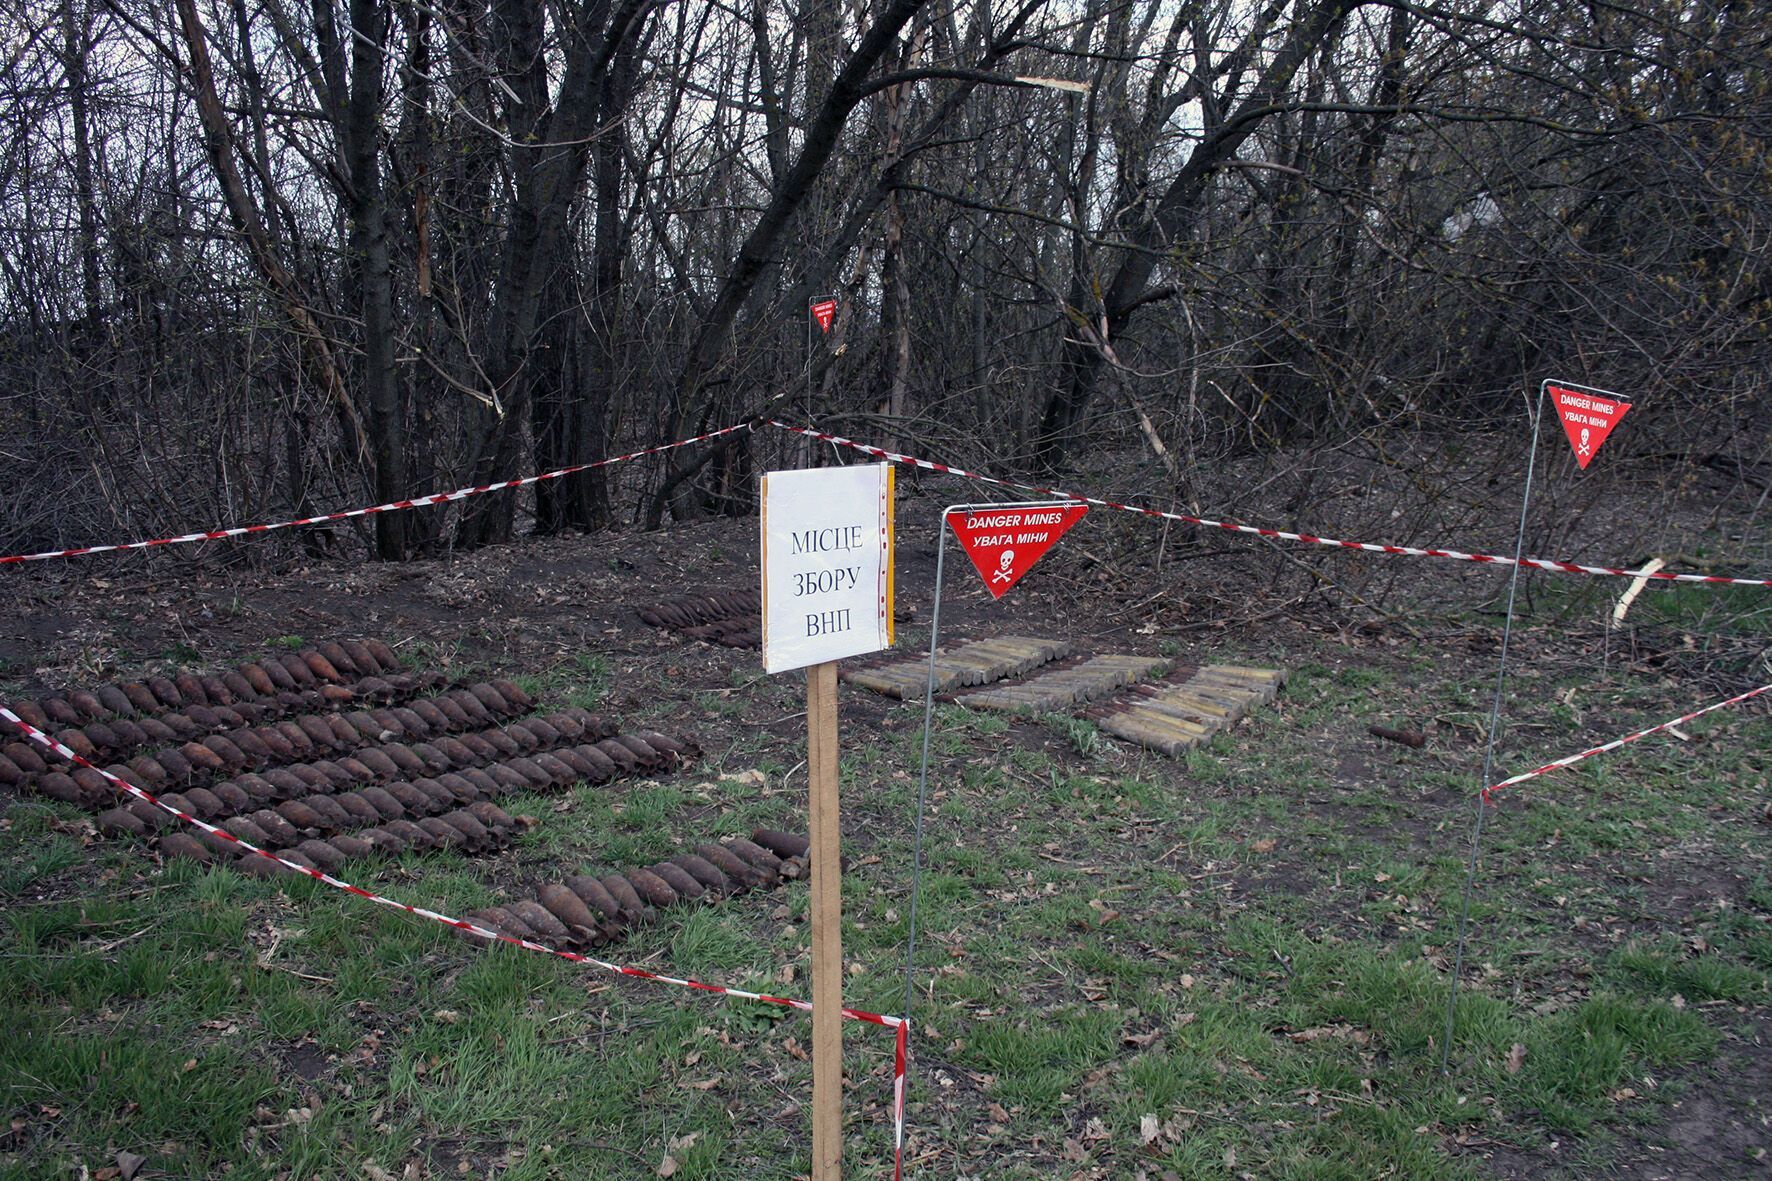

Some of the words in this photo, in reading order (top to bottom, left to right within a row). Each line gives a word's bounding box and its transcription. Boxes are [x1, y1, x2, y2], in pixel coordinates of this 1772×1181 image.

[1560, 394, 1591, 410] DANGER
[1591, 401, 1614, 415] MINES
[1564, 411, 1588, 425] УВАГА
[1588, 416, 1608, 428] МІНИ
[967, 514, 1021, 530] DANGER
[1023, 512, 1062, 526] MINES
[791, 525, 863, 555] МІСЦЕ
[973, 534, 1013, 547] УВАГА
[1016, 532, 1049, 544] МІНИ
[793, 566, 861, 597] ЗБОРУ
[805, 608, 851, 638] ВНП
